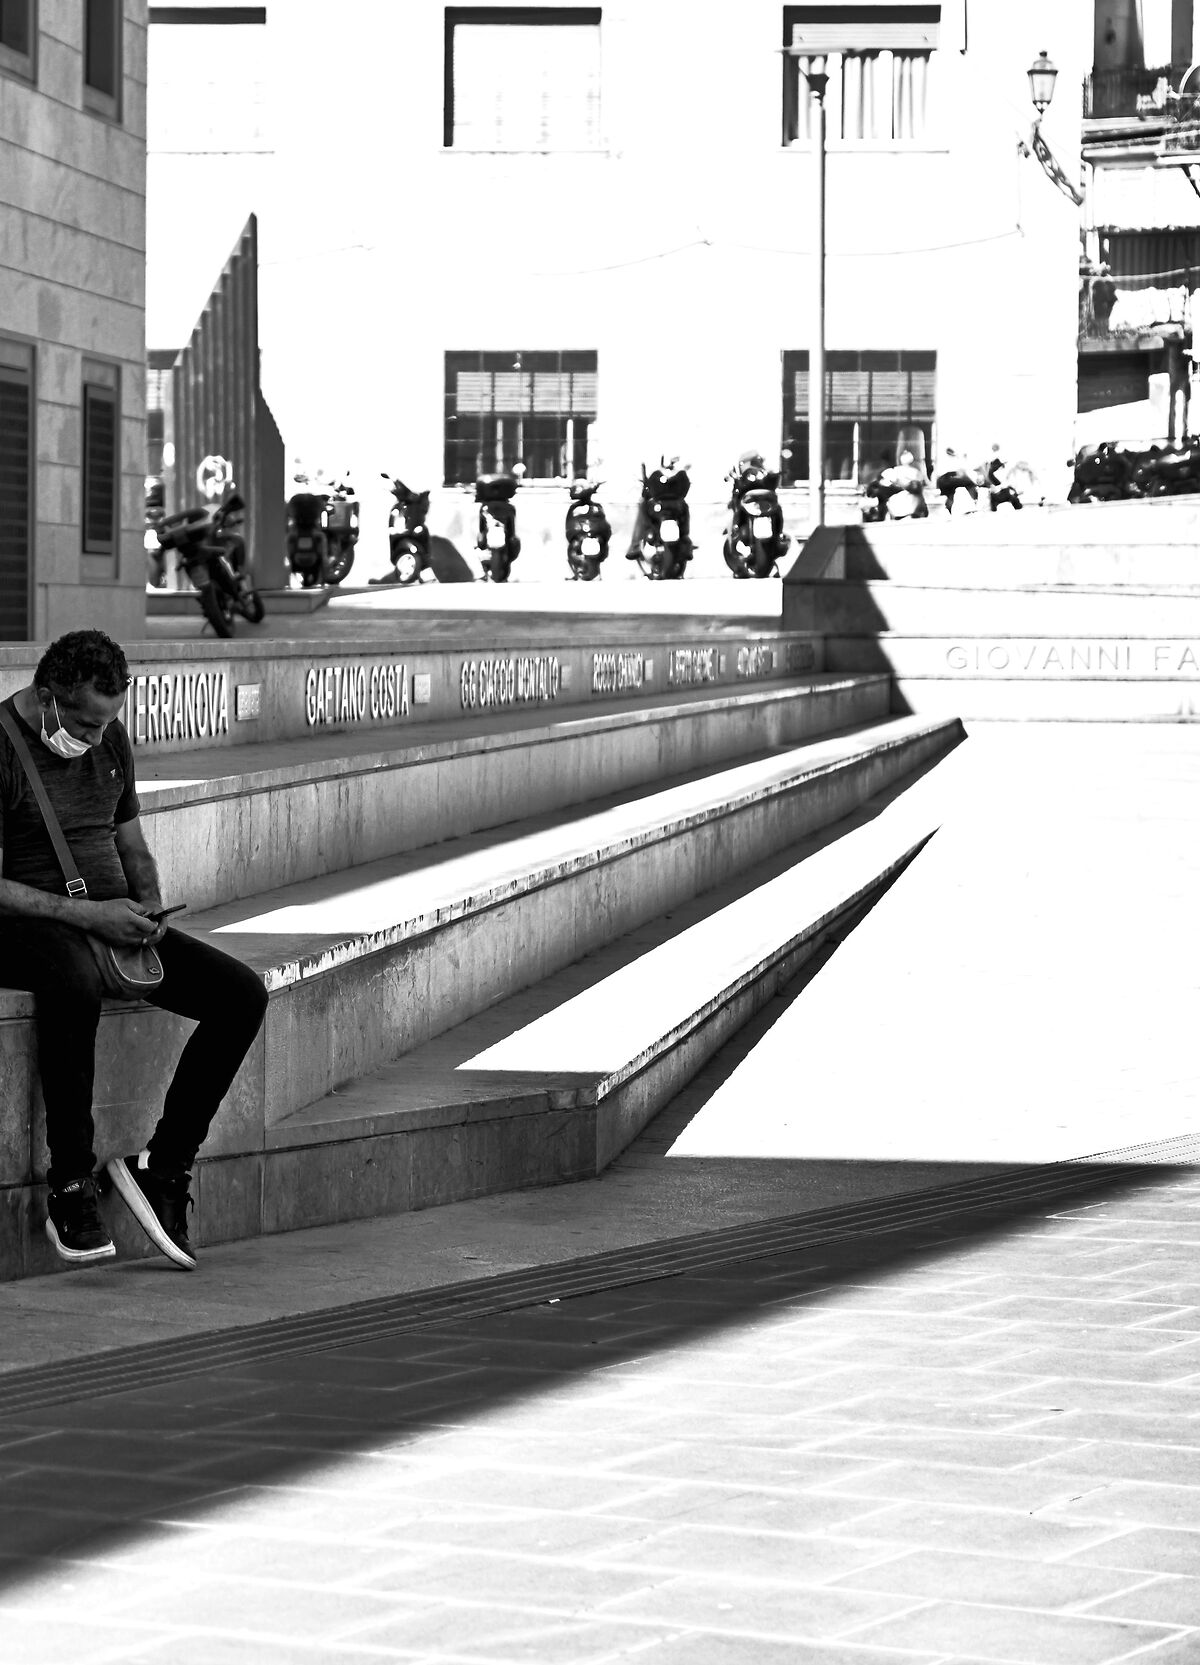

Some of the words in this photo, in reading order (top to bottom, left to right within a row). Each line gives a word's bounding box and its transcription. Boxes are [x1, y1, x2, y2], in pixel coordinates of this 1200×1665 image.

[945, 645, 1131, 671] GIOVANNI
[306, 666, 366, 726] GAETANO
[370, 664, 410, 719] COSTA
